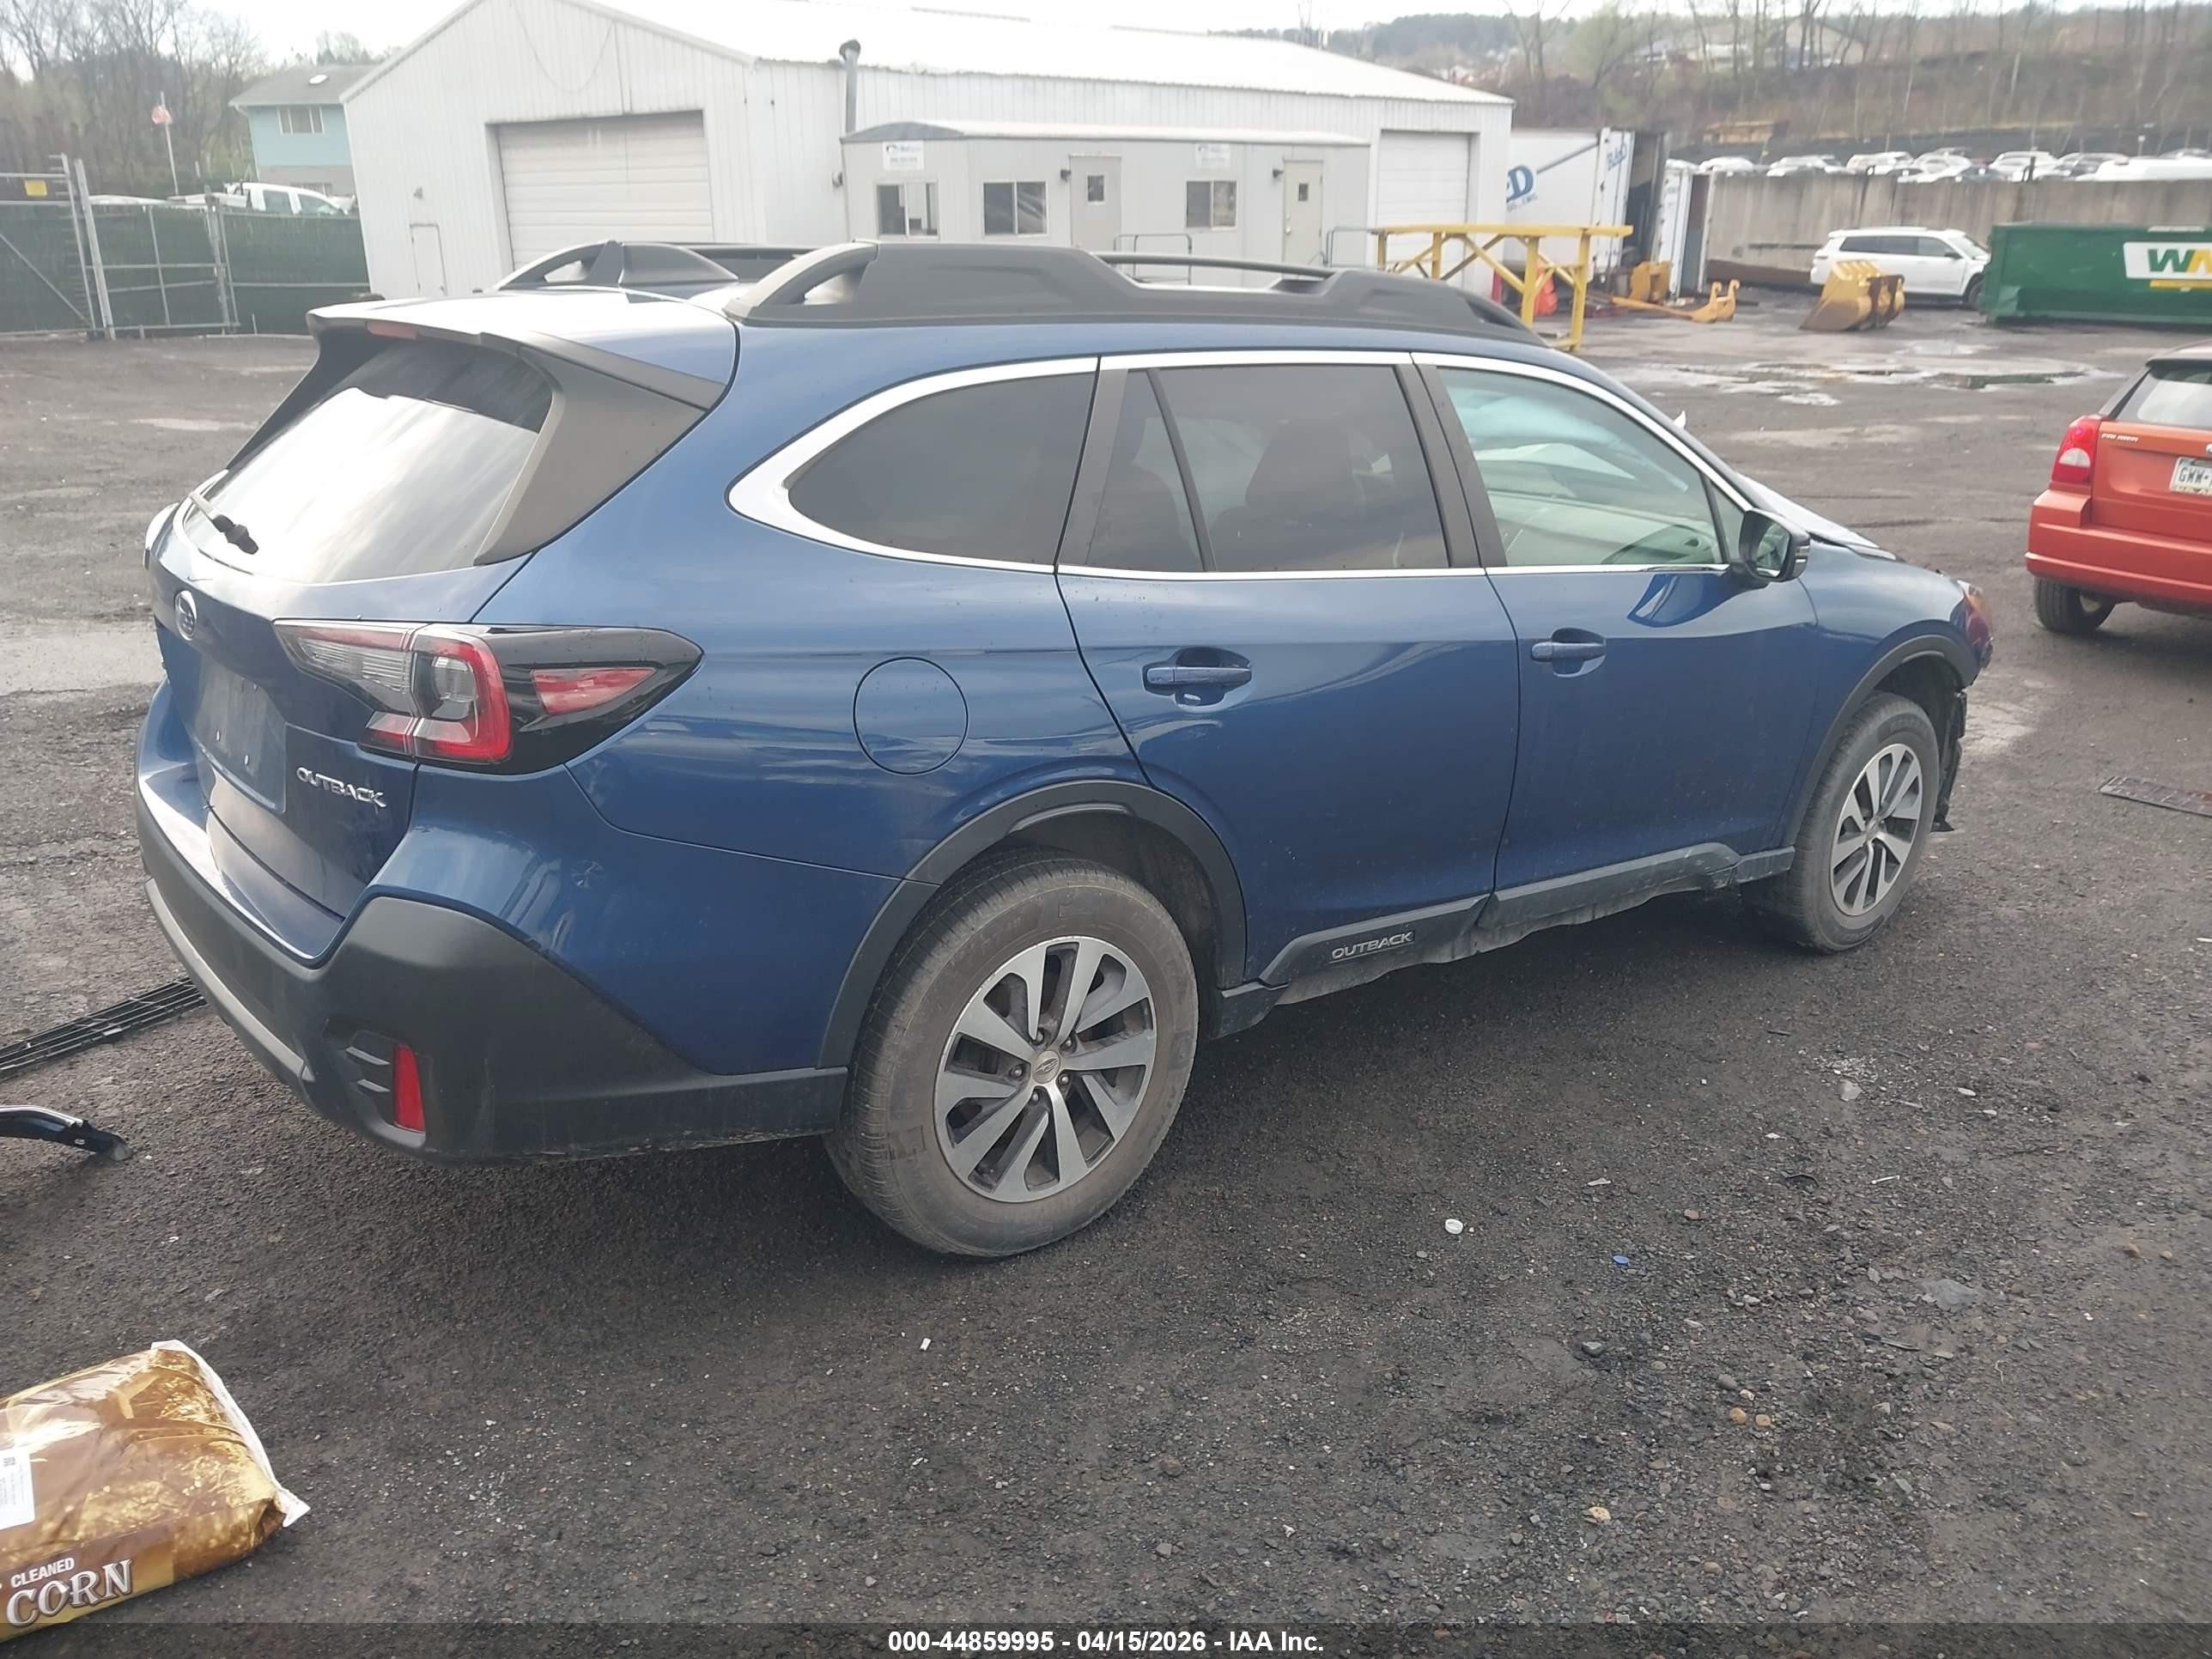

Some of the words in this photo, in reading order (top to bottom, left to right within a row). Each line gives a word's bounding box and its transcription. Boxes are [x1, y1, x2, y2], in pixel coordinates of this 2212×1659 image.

[1506, 165, 1534, 203] D
[296, 767, 386, 808] OUTBACK
[1332, 931, 1413, 960] OUTBACK
[10, 1557, 76, 1588] CLEANED
[6, 1559, 133, 1627] CORN
